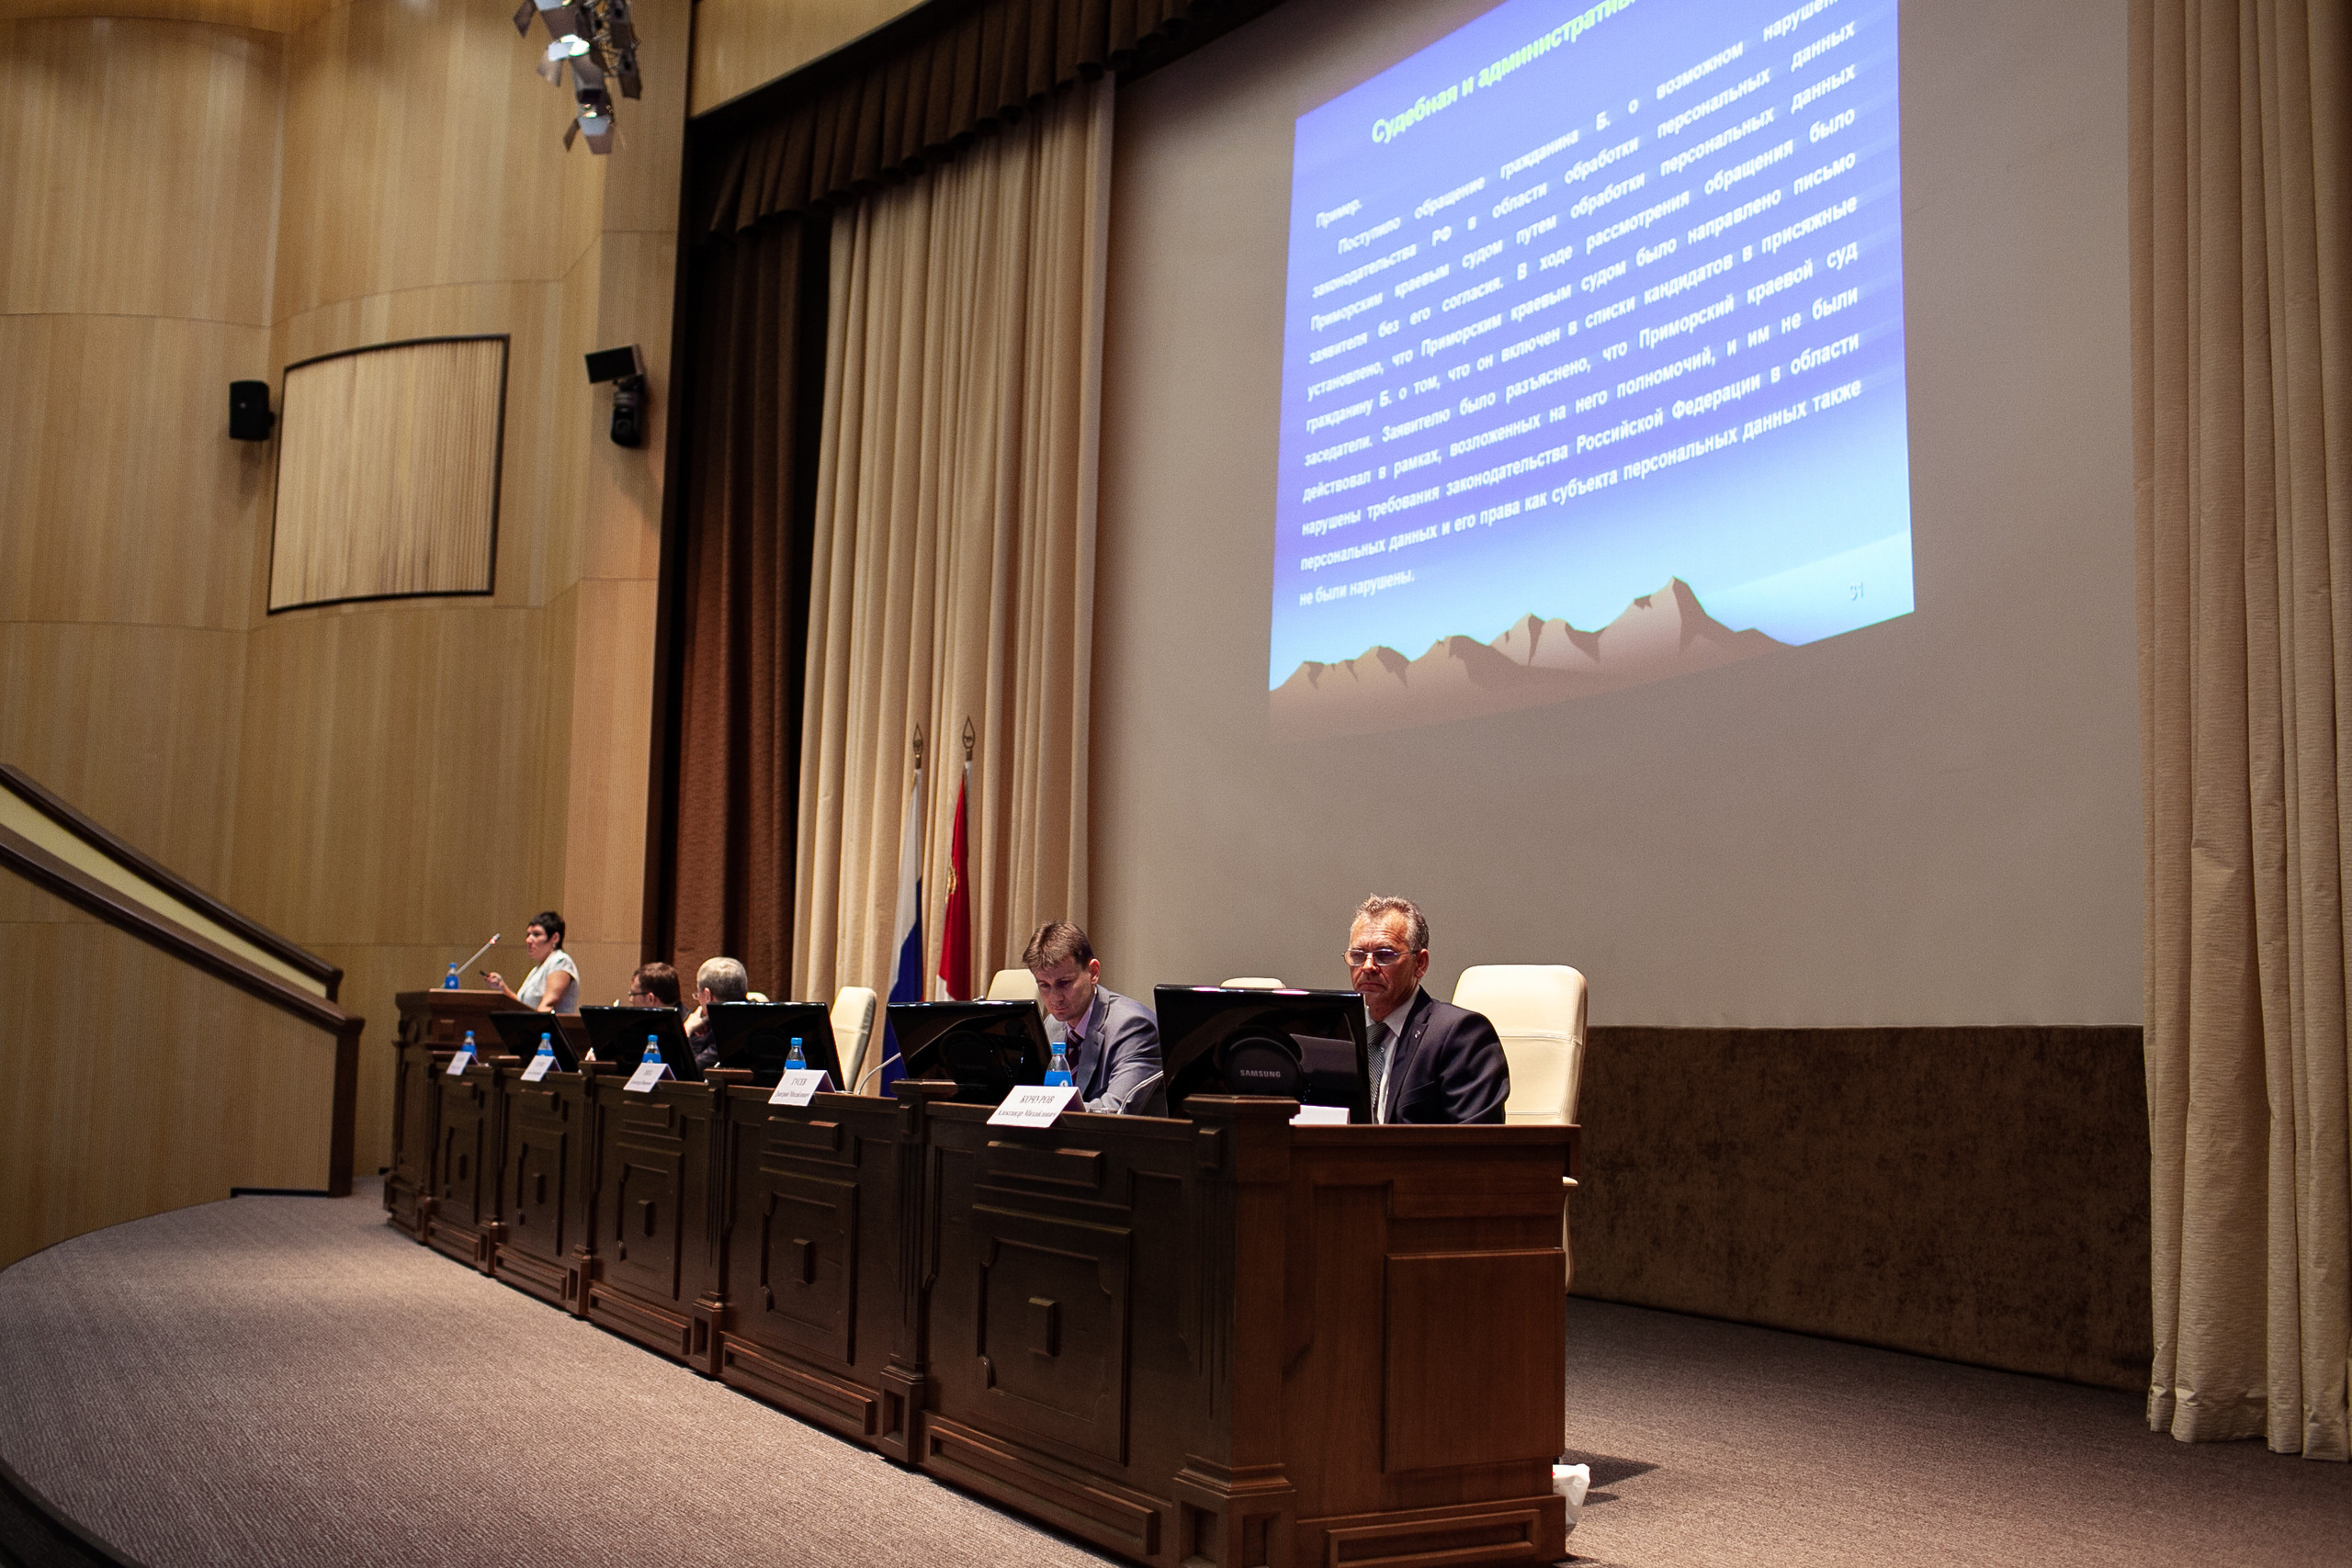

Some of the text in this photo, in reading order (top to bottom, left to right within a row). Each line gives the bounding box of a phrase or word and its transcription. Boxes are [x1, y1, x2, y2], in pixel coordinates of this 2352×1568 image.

[1312, 21, 1855, 298] законодательства РФ в области обработки персональных данных
[1339, 217, 1401, 254] Поступило
[1415, 177, 1486, 219] обращение
[1500, 130, 1579, 180] гражданина
[1596, 111, 1611, 130] Б.
[1628, 98, 1639, 114] о
[1657, 41, 1743, 99] возможном
[1372, 85, 1458, 143] Судебная
[1462, 76, 1475, 96] и
[1395, 264, 1449, 299] краевым
[1462, 240, 1503, 269] судом
[1516, 215, 1556, 245] путем
[1570, 173, 1645, 219] обработки
[1660, 107, 1775, 176] персональных
[1791, 63, 1856, 114] данных
[1306, 197, 1858, 434] гражданину Б. о том, что он включен в списки кандидатов в присяжные
[1307, 152, 1856, 401] установлено, что Приморским краевым судом было направлено письмо
[1309, 108, 1855, 364] заявителя без его согласия. В ходе рассмотрения обращения было
[1302, 333, 1860, 536] нарушены требования законодательства Российской Федерации в области
[1303, 287, 1858, 503] действовал в рамках, возложенных на него полномочий, и им не были
[1305, 242, 1859, 466] заседатели. Заявителю было разъяснено, что Приморский краевой суд
[1301, 380, 1861, 571] персональных данных и его права как субъекта персональных данных также
[1300, 570, 1414, 605] не были нарушены.
[1239, 1069, 1281, 1078] SAMSUNG
